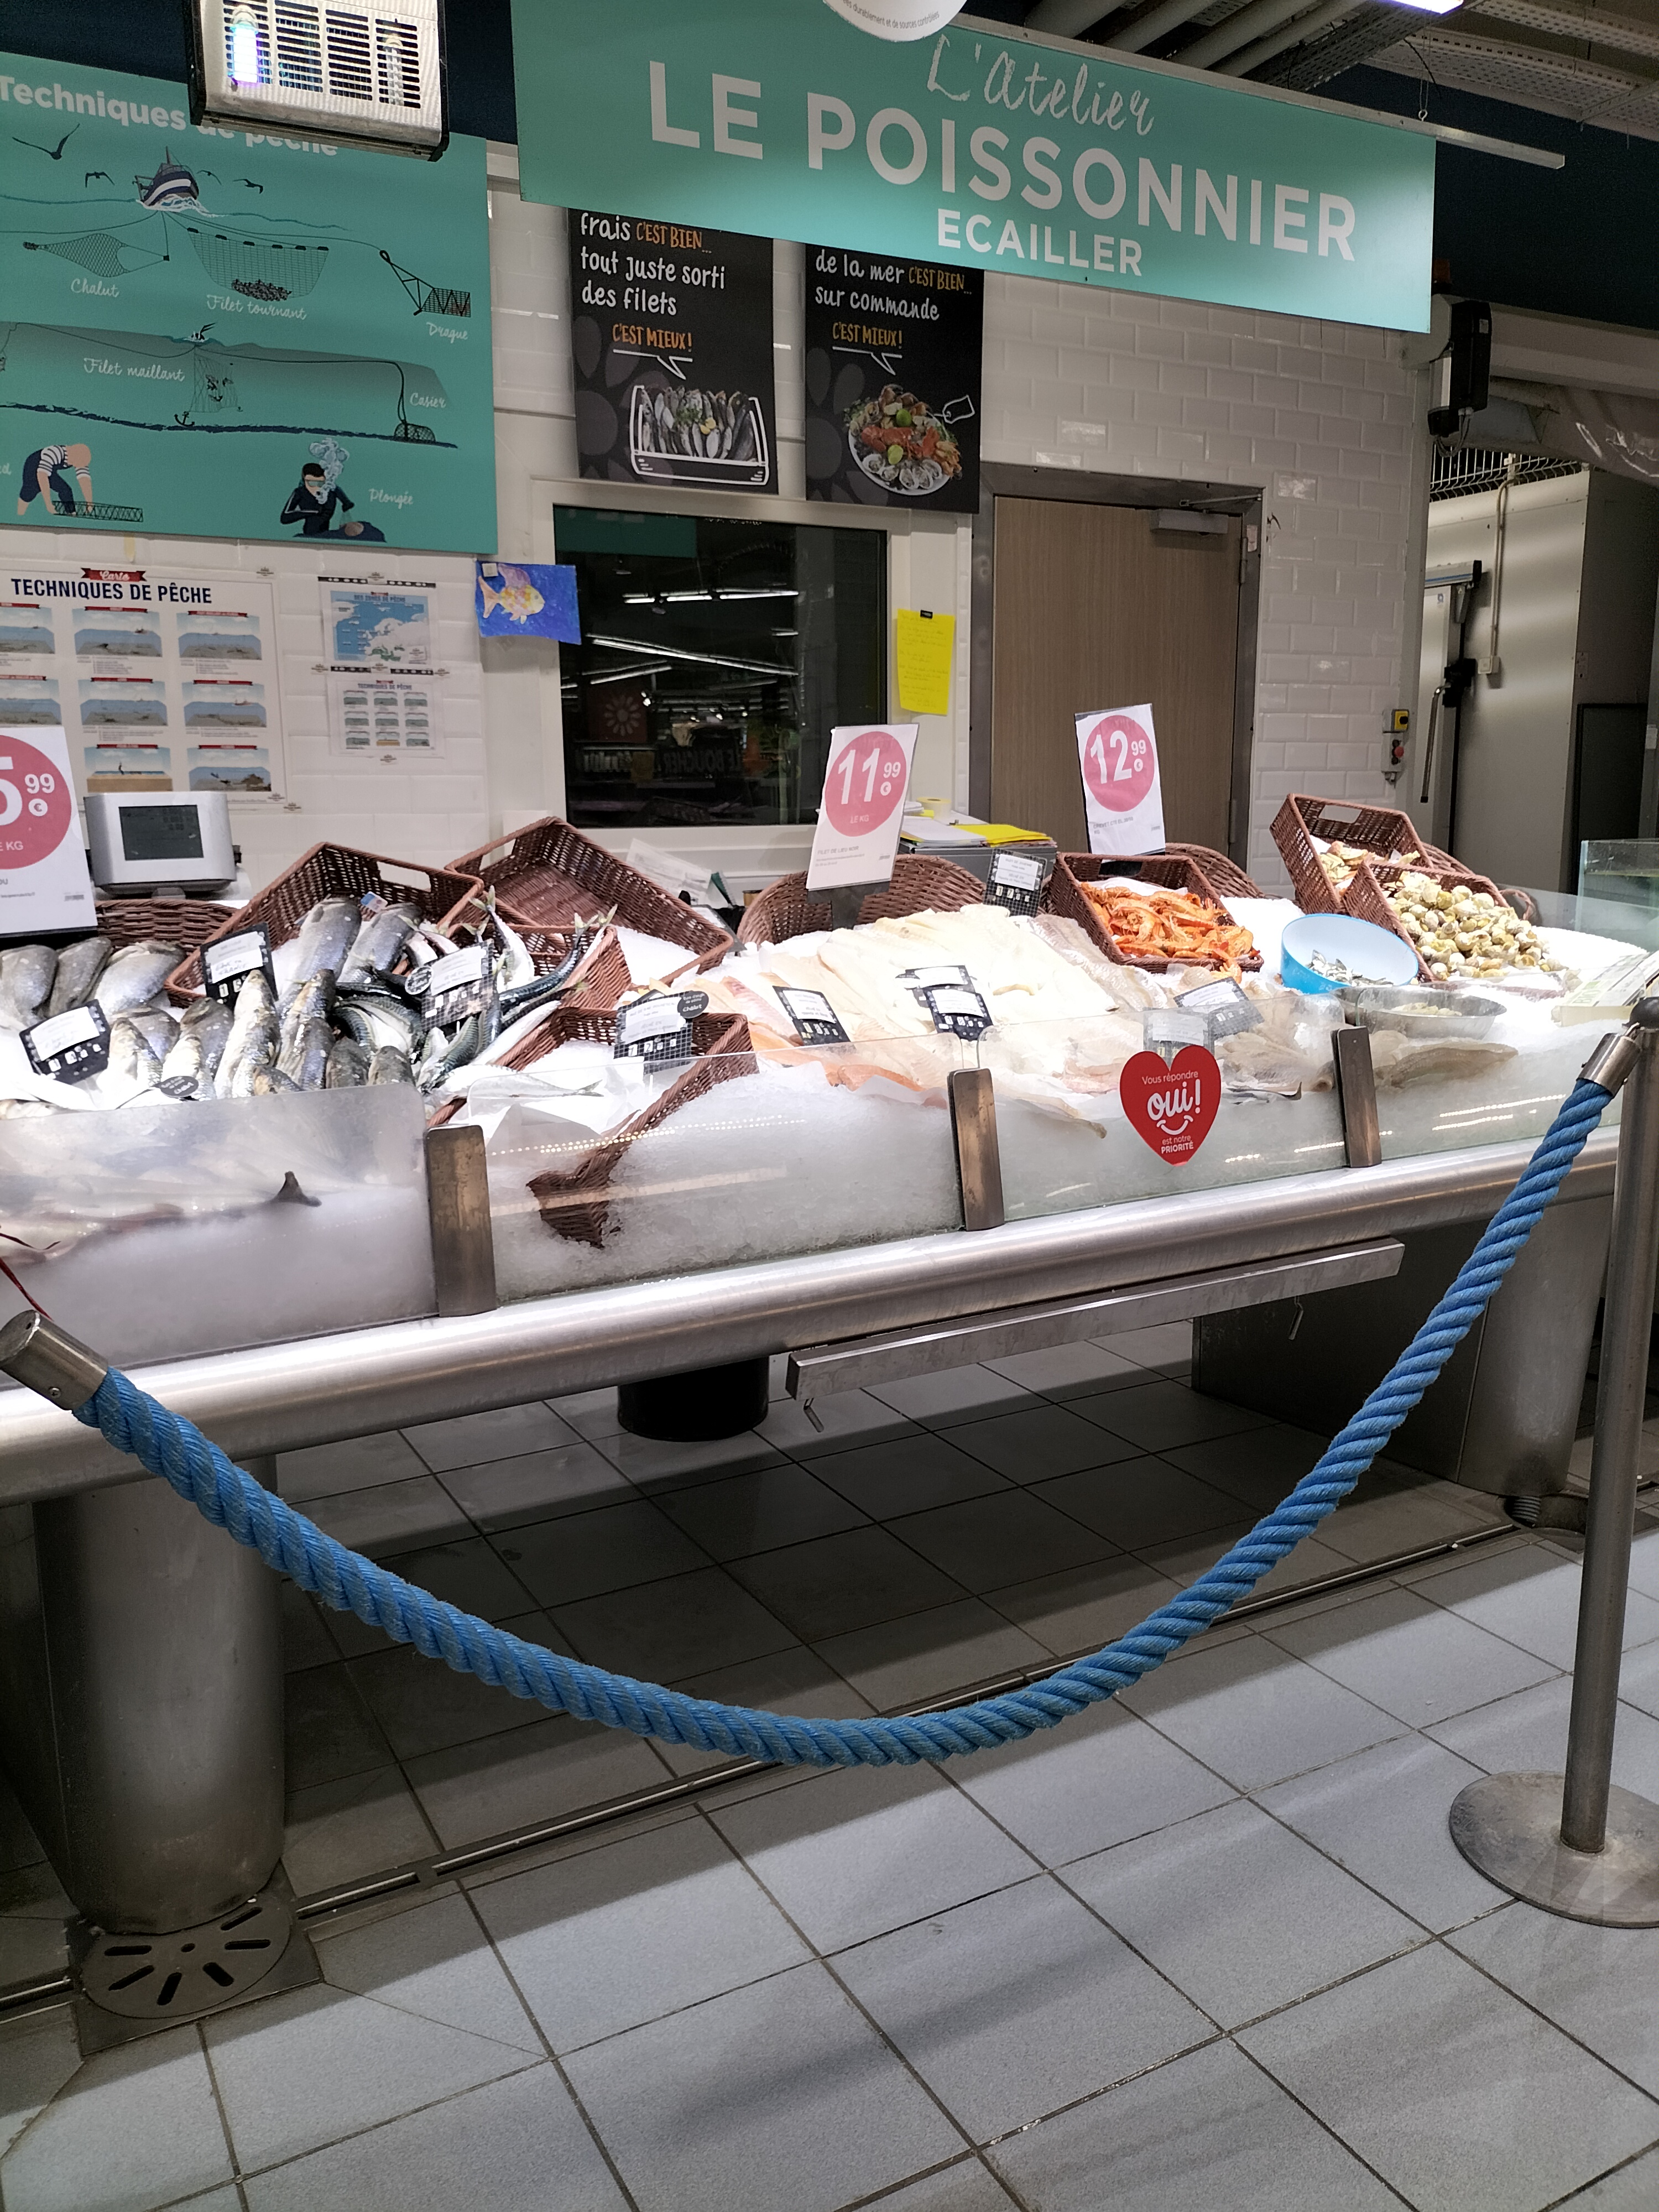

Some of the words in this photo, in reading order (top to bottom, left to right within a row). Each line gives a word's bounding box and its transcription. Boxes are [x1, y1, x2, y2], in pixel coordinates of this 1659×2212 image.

[853, 3, 885, 26] durablement
[886, 19, 891, 27] et
[892, 19, 899, 28] de
[899, 20, 917, 29] sources
[0, 75, 186, 131] Techniques
[649, 60, 764, 160] LE
[807, 91, 1355, 262] POISSONNIER
[581, 212, 631, 241] frais
[636, 222, 667, 245] C'EST
[937, 208, 1142, 276] ECAILLER
[581, 246, 619, 275] tout
[682, 265, 726, 289] sorti
[815, 249, 837, 274] de
[844, 254, 865, 278] la
[870, 265, 905, 284] mer
[909, 266, 936, 288] C'EST
[71, 278, 119, 298] Chalut
[582, 280, 617, 307] des
[623, 287, 677, 316] filets
[207, 294, 243, 313] Filet
[248, 300, 307, 320] tournant
[815, 286, 845, 307] sur
[849, 291, 940, 321] commande
[612, 323, 644, 346] C'EST
[832, 322, 861, 343] C'EST
[84, 358, 122, 375] Filet
[127, 362, 185, 382] maillant
[409, 393, 446, 408] Casier
[368, 488, 414, 509] Plongée
[11, 578, 123, 600] TECHNIQUES
[131, 584, 152, 601] DE
[158, 583, 212, 604] PÊCHE
[6, 841, 23, 851] KG
[1142, 1075, 1161, 1085] Vous
[1163, 1070, 1198, 1083] répondre
[1161, 1140, 1194, 1154] PRIORITÉ
[1162, 1137, 1172, 1145] est
[1173, 1135, 1191, 1144] notre
